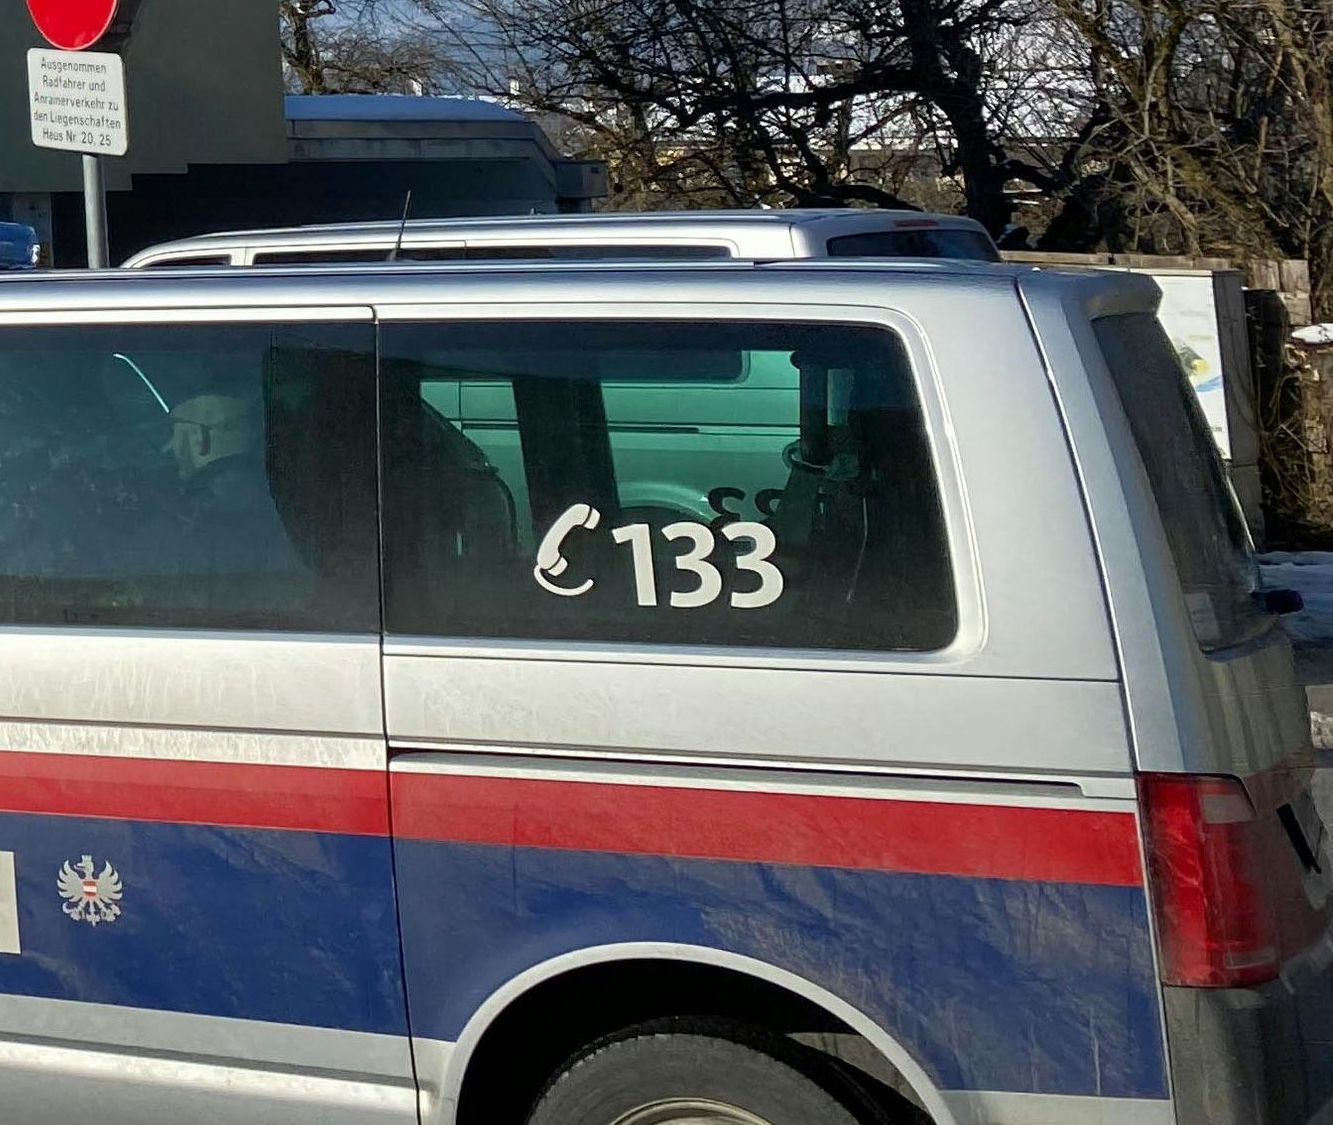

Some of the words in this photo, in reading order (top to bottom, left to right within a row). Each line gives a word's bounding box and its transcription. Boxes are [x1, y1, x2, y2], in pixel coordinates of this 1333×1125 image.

[41, 57, 107, 74] Ausgenommen
[43, 75, 86, 90] Radfahrer
[89, 80, 106, 92] und
[108, 102, 119, 111] zu
[33, 110, 48, 121] den
[50, 111, 121, 129] Liegenschaften
[43, 128, 63, 142] Haus
[99, 134, 112, 146] 25
[612, 521, 784, 608] 133
